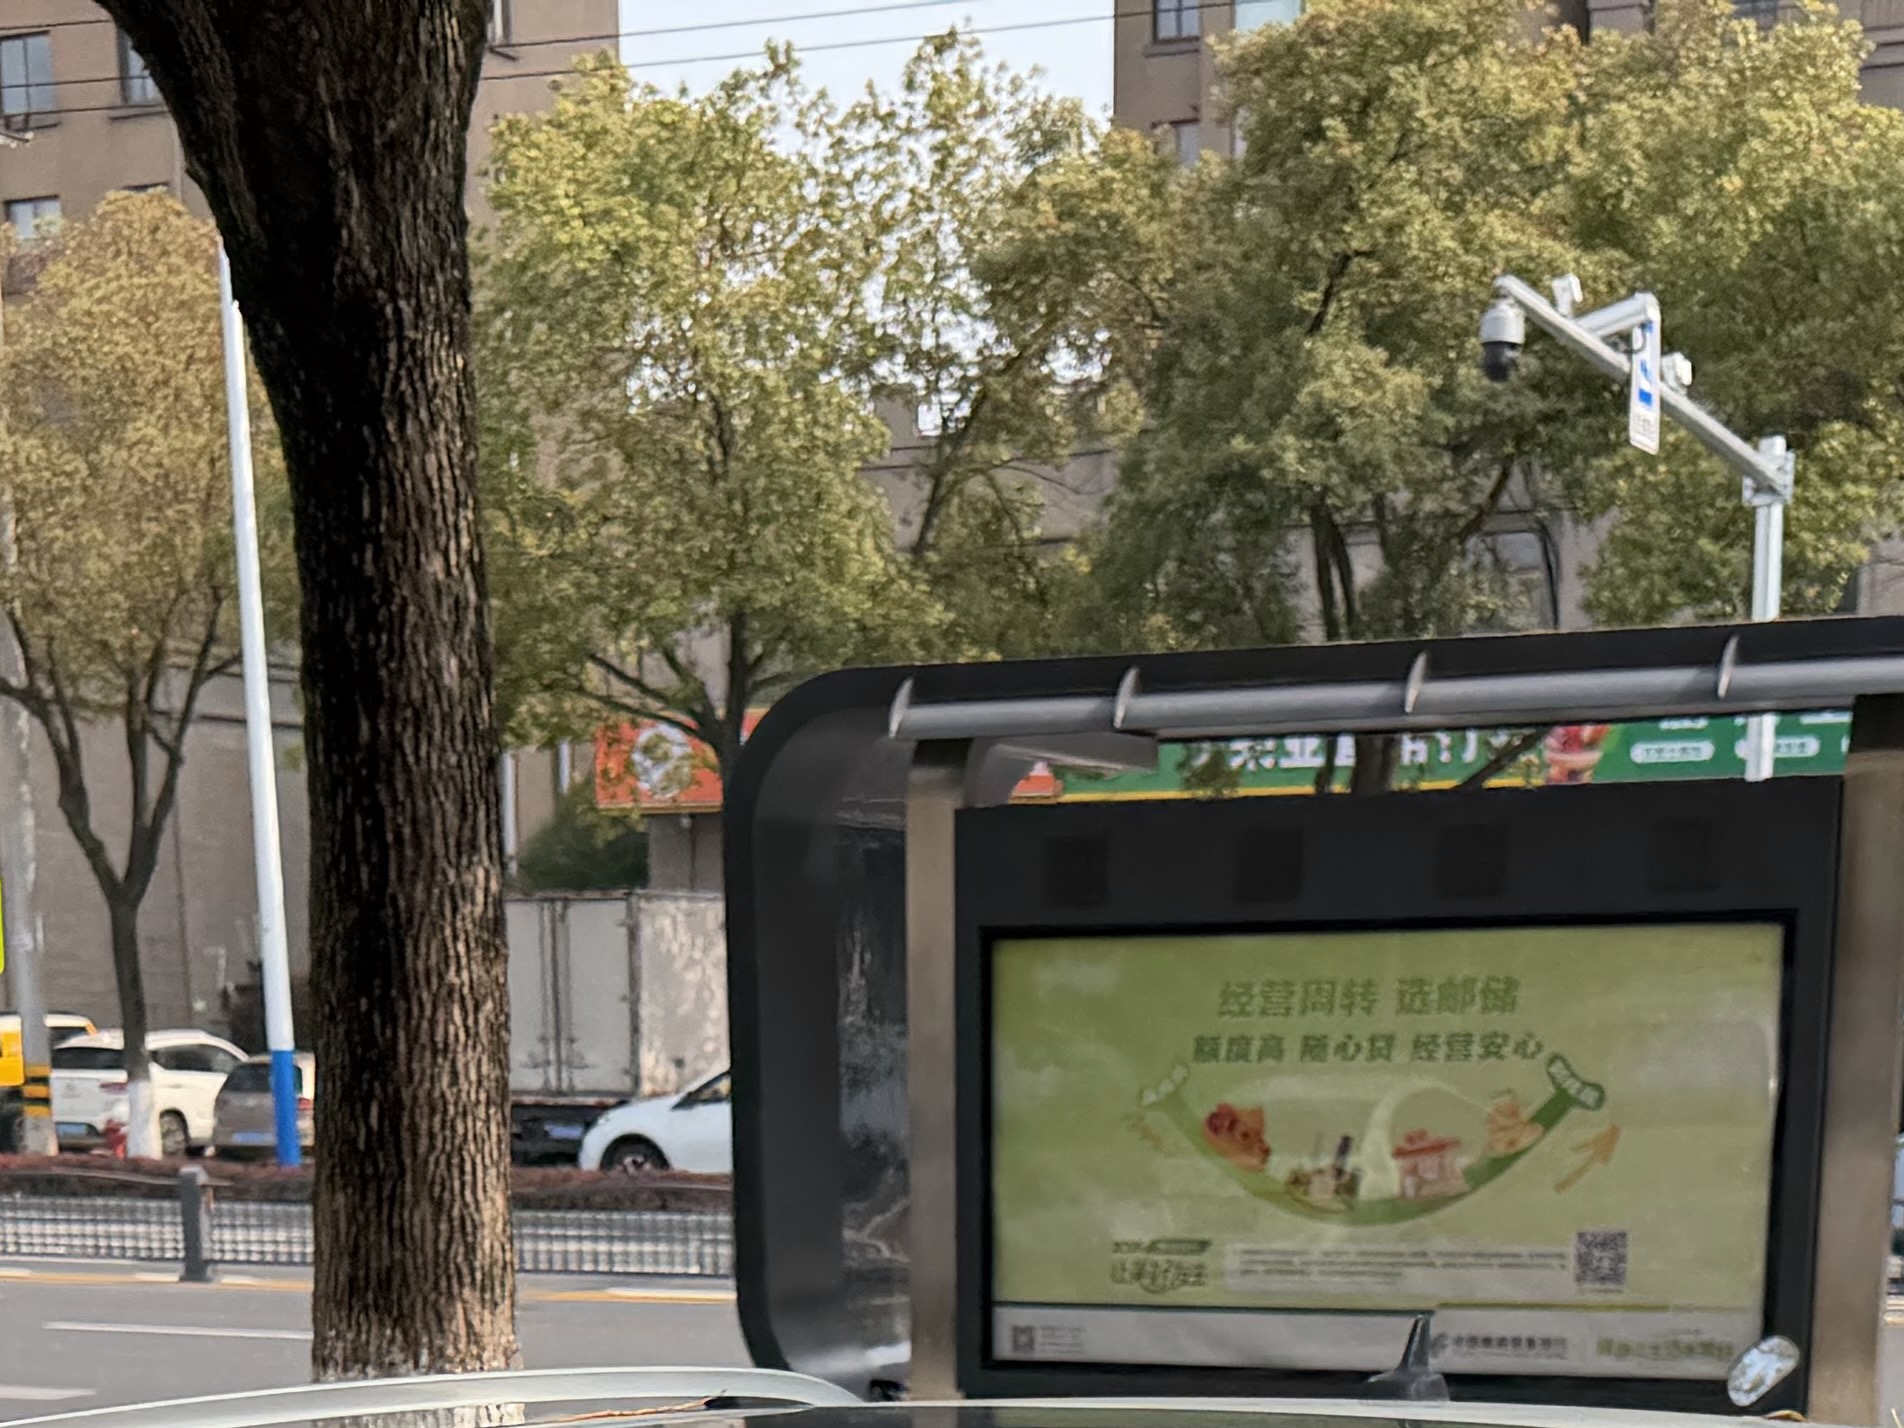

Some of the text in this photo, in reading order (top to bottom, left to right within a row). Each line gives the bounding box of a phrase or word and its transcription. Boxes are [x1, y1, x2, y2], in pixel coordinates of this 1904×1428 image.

[1217, 975, 1522, 1018] 经营周转 选邮储
[1410, 1031, 1545, 1062] 经营安心
